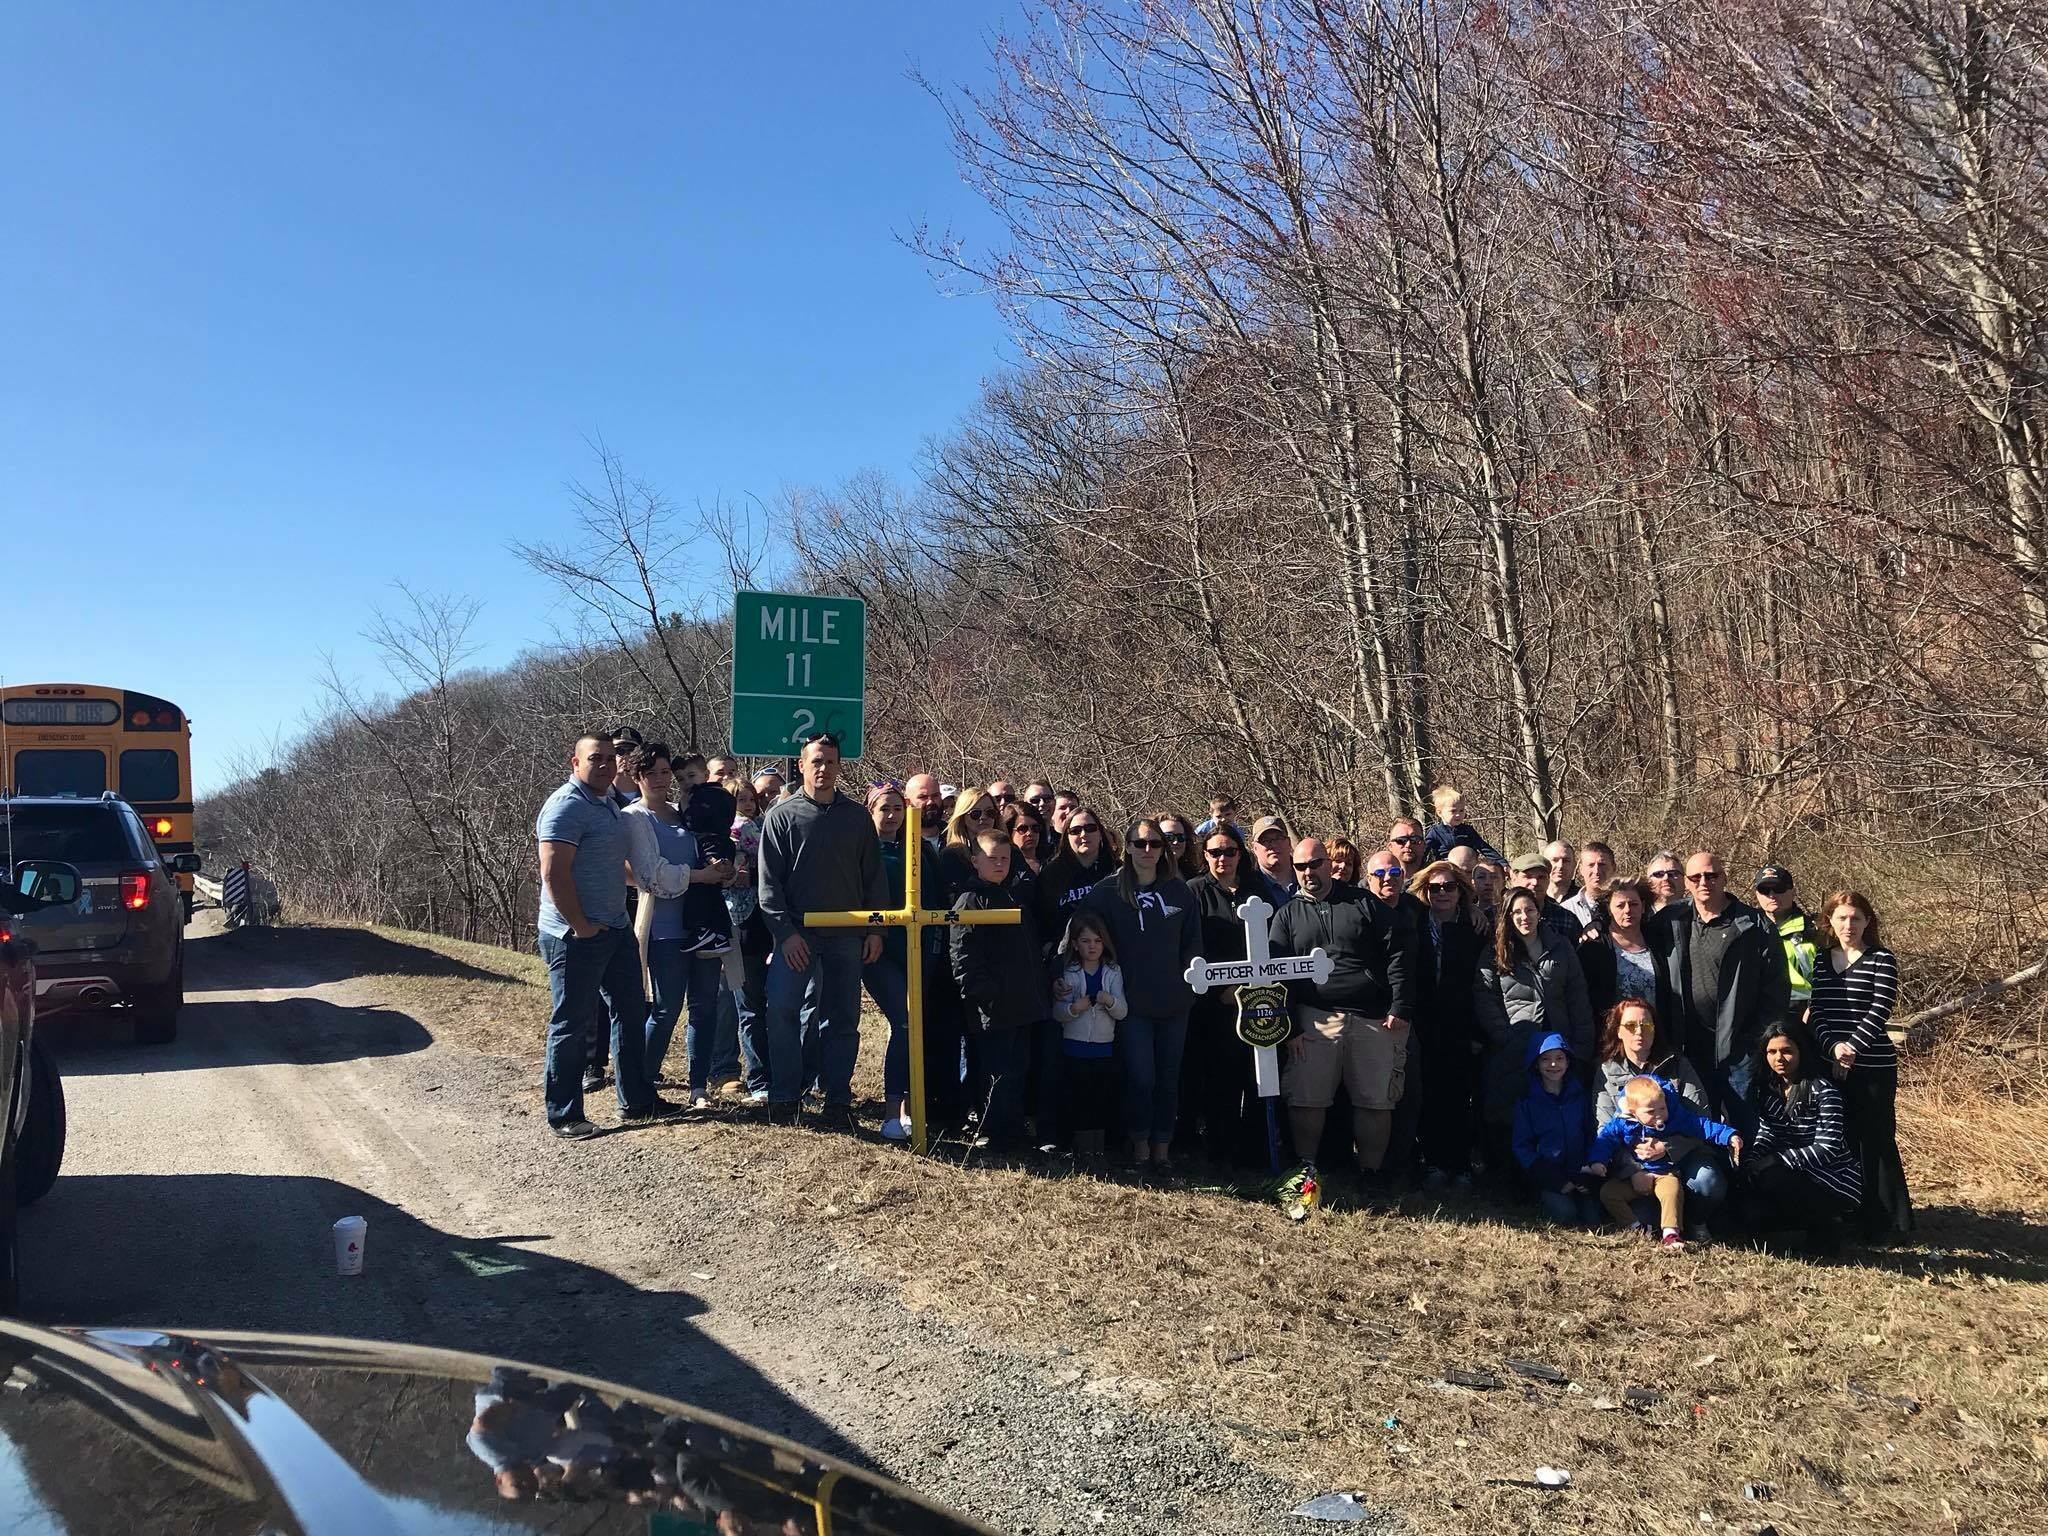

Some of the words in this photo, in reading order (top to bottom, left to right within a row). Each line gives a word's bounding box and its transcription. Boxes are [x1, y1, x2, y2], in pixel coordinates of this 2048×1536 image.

[760, 605, 840, 645] MILE
[785, 652, 811, 688] 11
[15, 704, 66, 721] SCHOOL
[75, 704, 103, 721] BUS
[1205, 965, 1254, 980] OFFICER
[1259, 962, 1287, 977] MIKE
[1293, 960, 1315, 974] LEE
[1241, 989, 1266, 1003] WEBSTER
[1266, 989, 1284, 1001] POLICE
[1256, 1009, 1274, 1017] 1126
